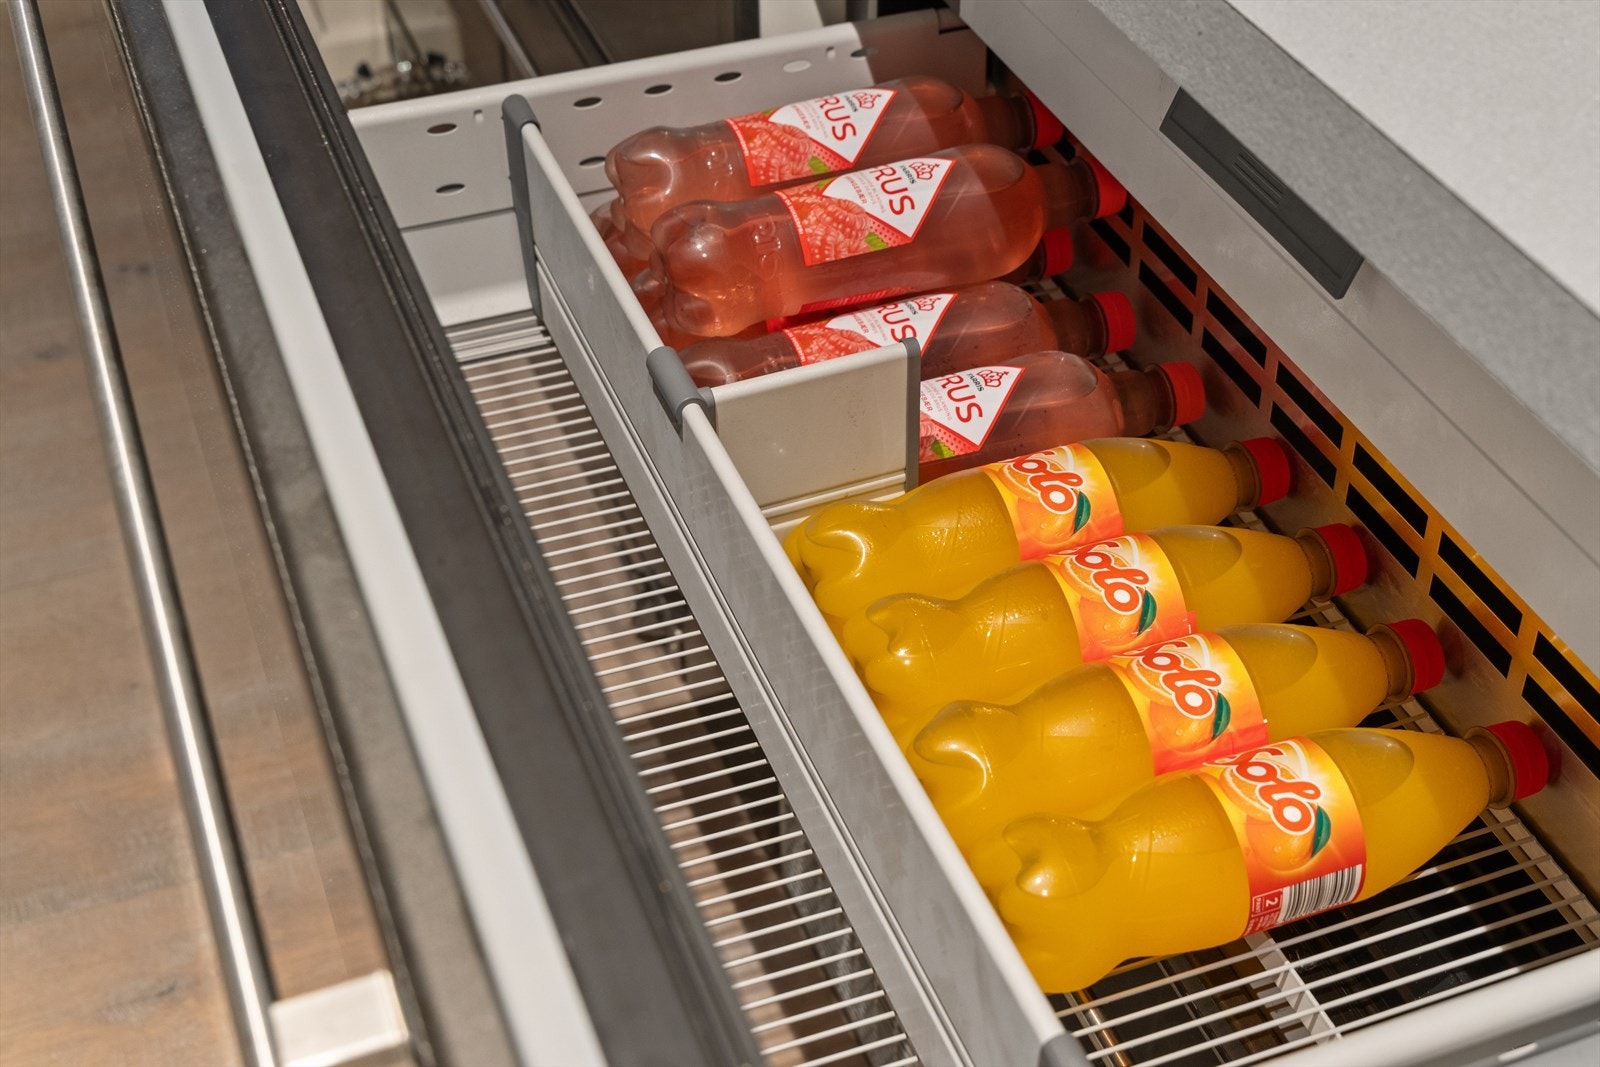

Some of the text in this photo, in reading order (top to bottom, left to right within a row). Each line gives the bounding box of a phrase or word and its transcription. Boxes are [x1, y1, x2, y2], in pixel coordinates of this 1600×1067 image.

[818, 95, 857, 141] RUS
[900, 165, 916, 184] FARRIS
[869, 164, 915, 216] RUS
[877, 303, 917, 342] RUS
[903, 301, 918, 315] ARRIS
[966, 373, 985, 392] FARRIS
[935, 374, 983, 423] RUS
[1265, 897, 1279, 907] 2
